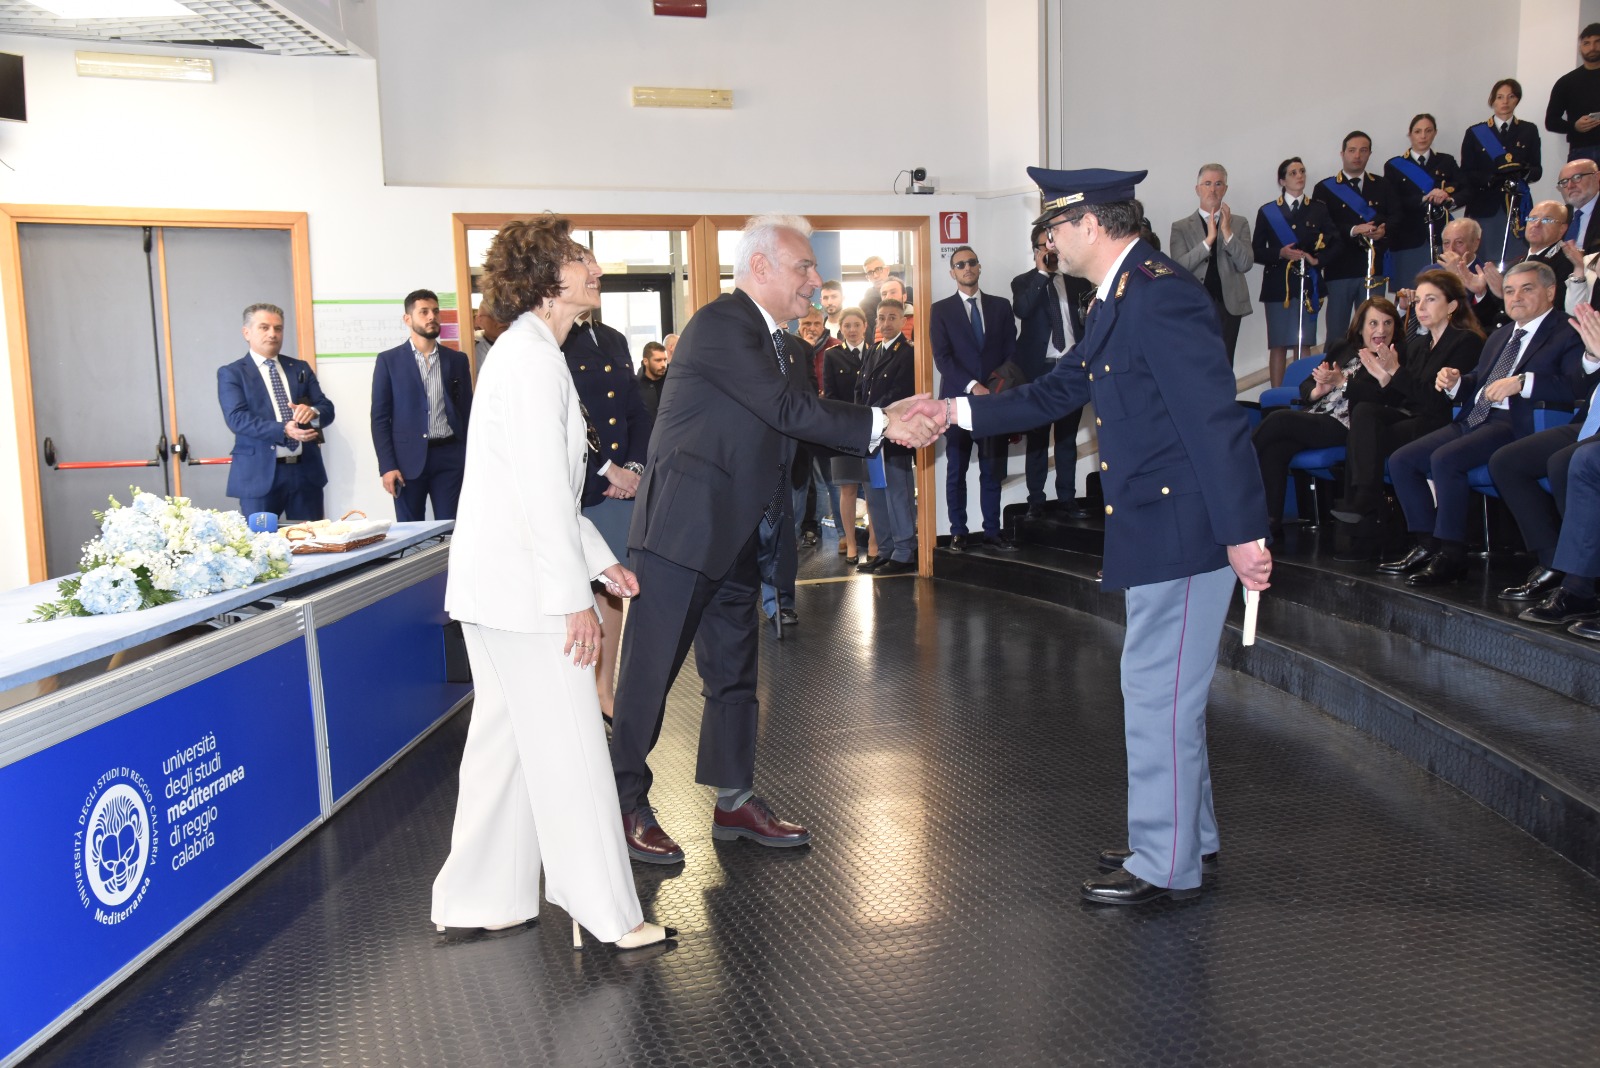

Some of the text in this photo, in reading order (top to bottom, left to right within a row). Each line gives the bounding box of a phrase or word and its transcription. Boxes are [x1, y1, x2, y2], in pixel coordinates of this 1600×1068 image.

[163, 731, 217, 775] università
[165, 752, 222, 799] degli studi
[166, 765, 245, 823] mediterranea
[74, 767, 159, 909] UNIVERSITÀ DEGLI STUDI DI REGGIO CALABRIA
[169, 806, 218, 847] di reggio
[171, 831, 215, 871] calabria
[94, 877, 151, 925] Mediterranea
